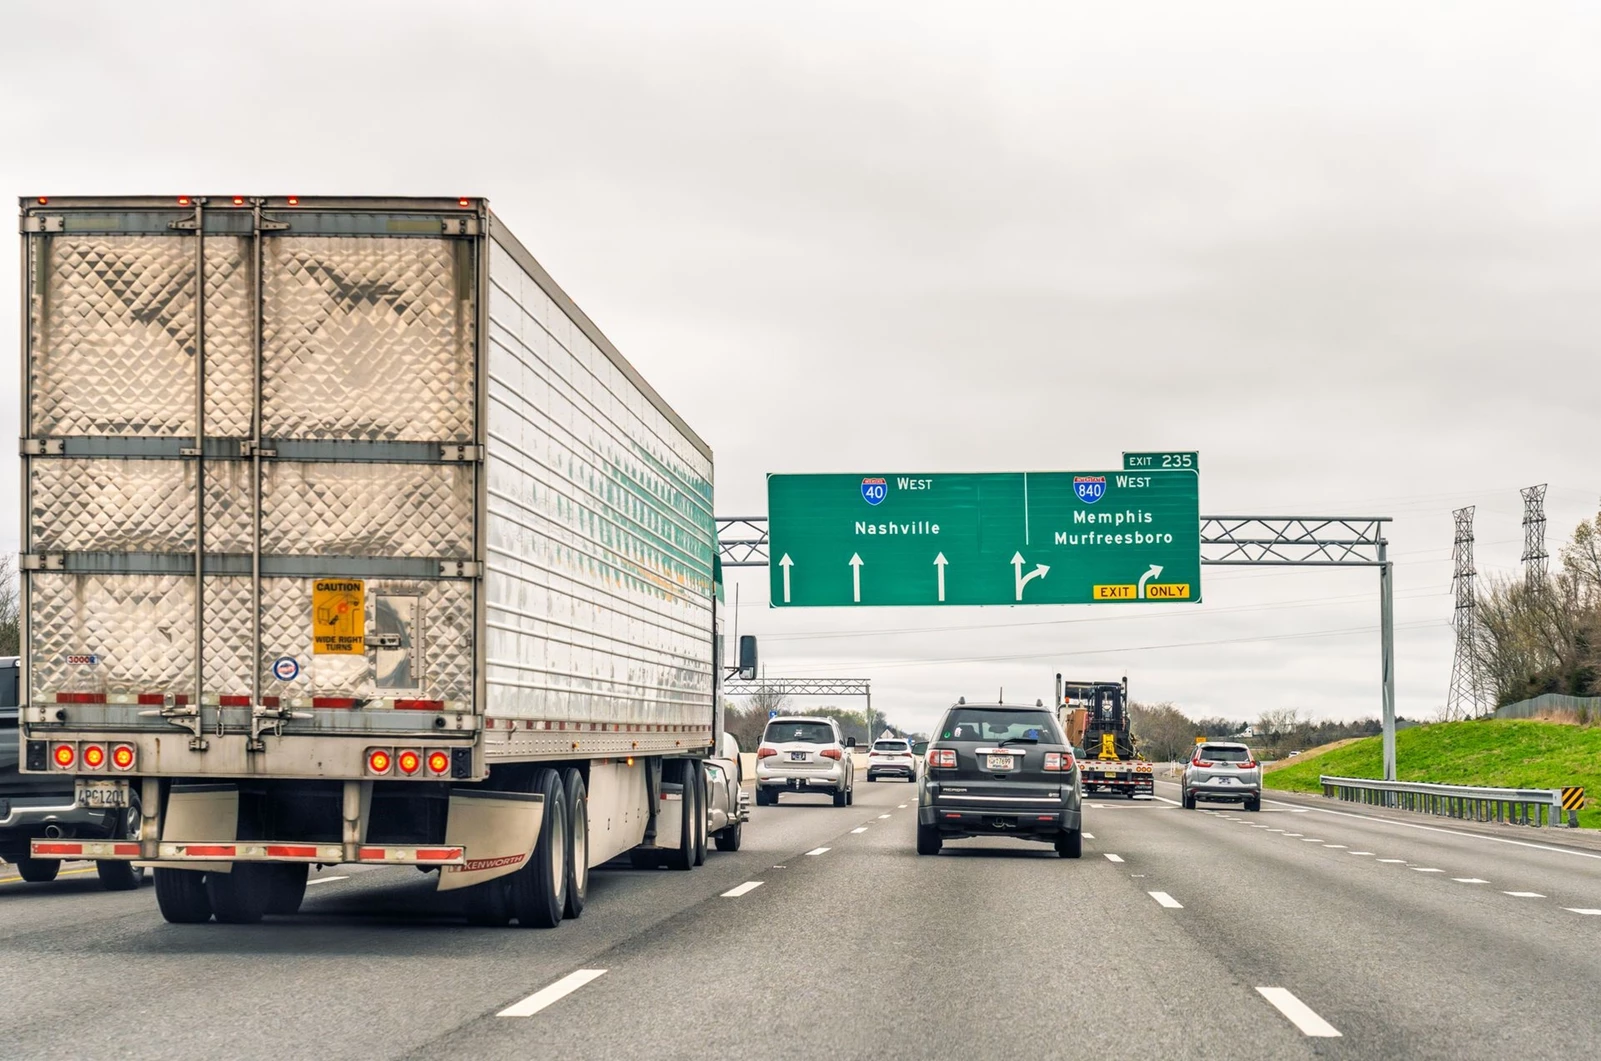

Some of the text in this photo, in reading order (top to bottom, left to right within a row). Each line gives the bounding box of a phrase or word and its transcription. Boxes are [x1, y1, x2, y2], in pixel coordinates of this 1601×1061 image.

[1129, 454, 1192, 468] EXIT 235
[865, 477, 933, 499] 40 WEST
[1078, 475, 1151, 497] 840 WEST
[1073, 510, 1153, 526] Memphis
[855, 521, 940, 535] Nashville
[1054, 531, 1173, 545] Murfreesboro
[316, 583, 361, 591] CAUTION
[1100, 586, 1185, 597] EXIT ONLY
[464, 855, 523, 870] KENWORTH
